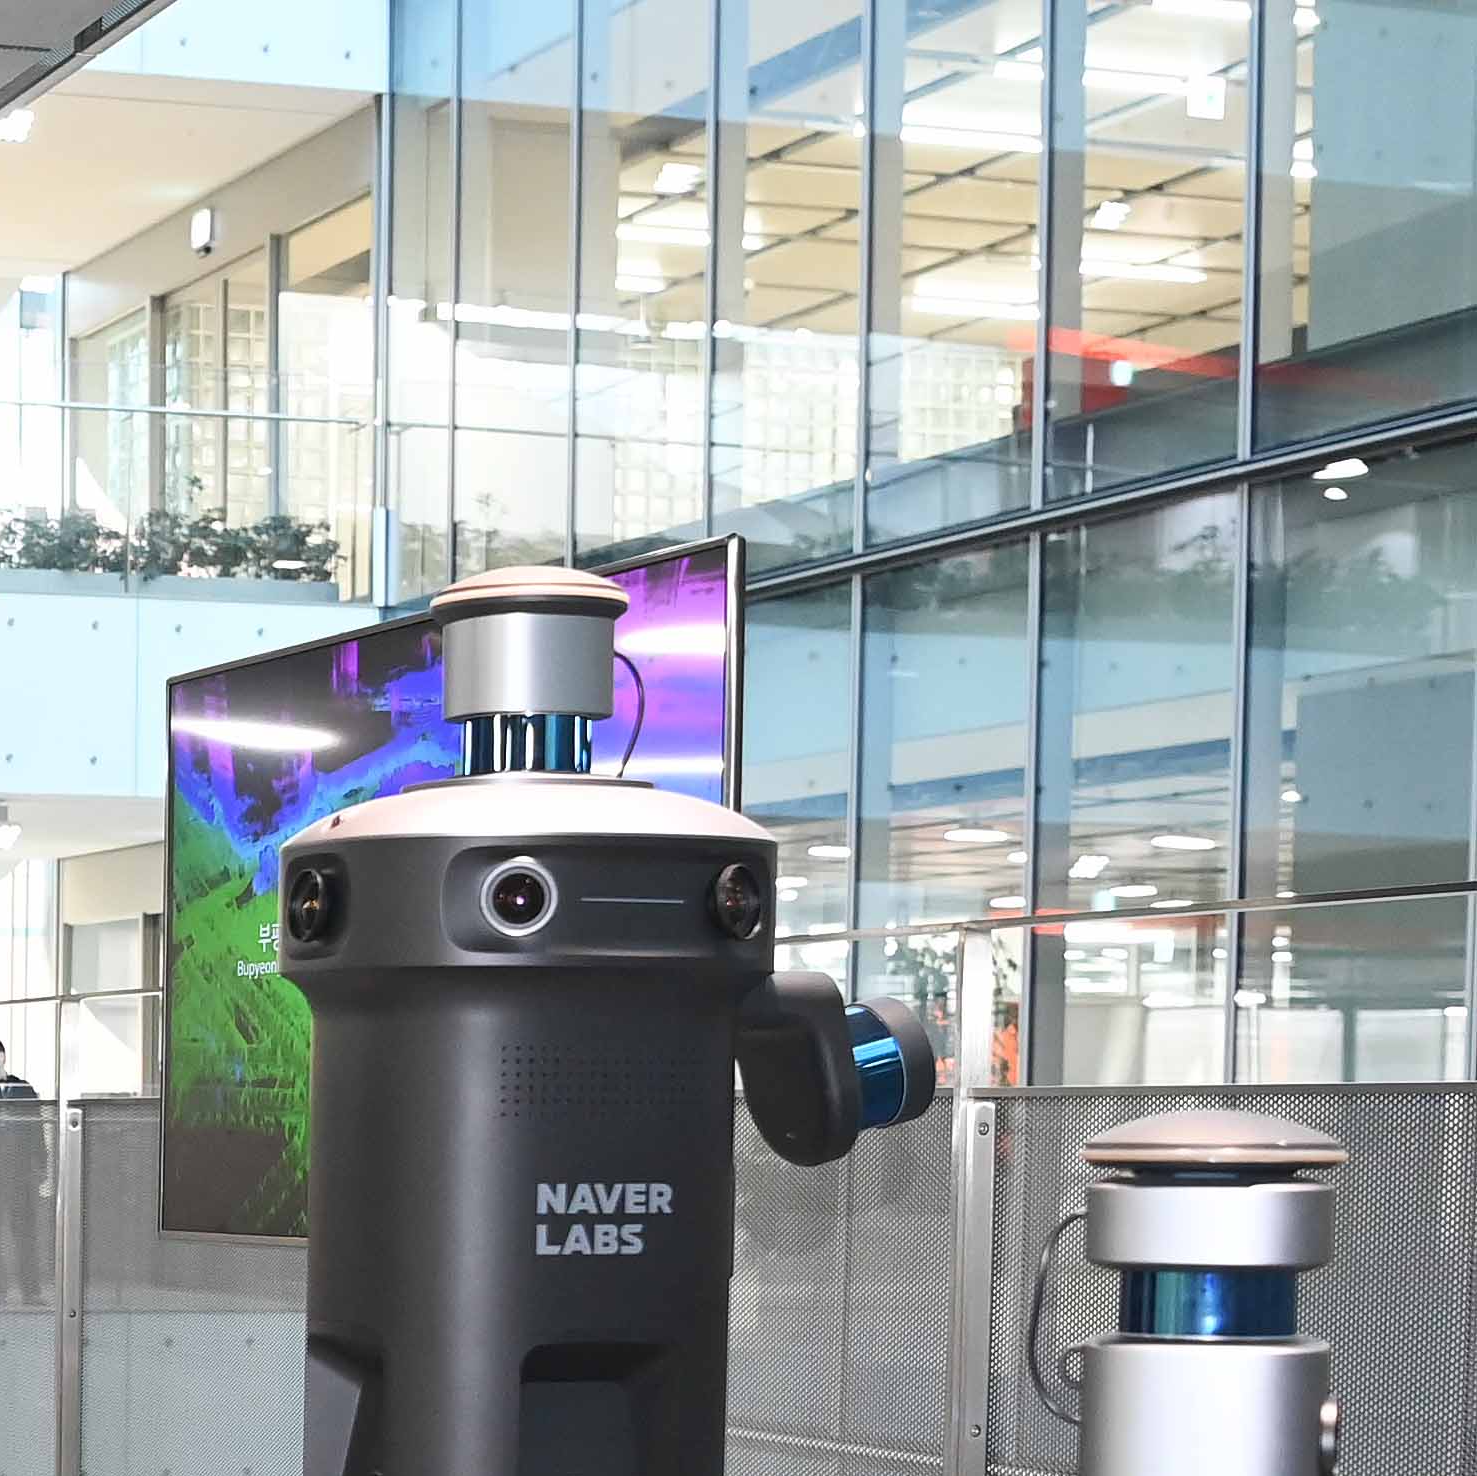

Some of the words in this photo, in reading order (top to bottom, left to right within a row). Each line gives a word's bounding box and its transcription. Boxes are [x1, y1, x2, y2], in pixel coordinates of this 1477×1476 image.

[237, 960, 280, 980] Bupyeon
[535, 1182, 673, 1215] NAVER
[535, 1223, 644, 1256] LABS
